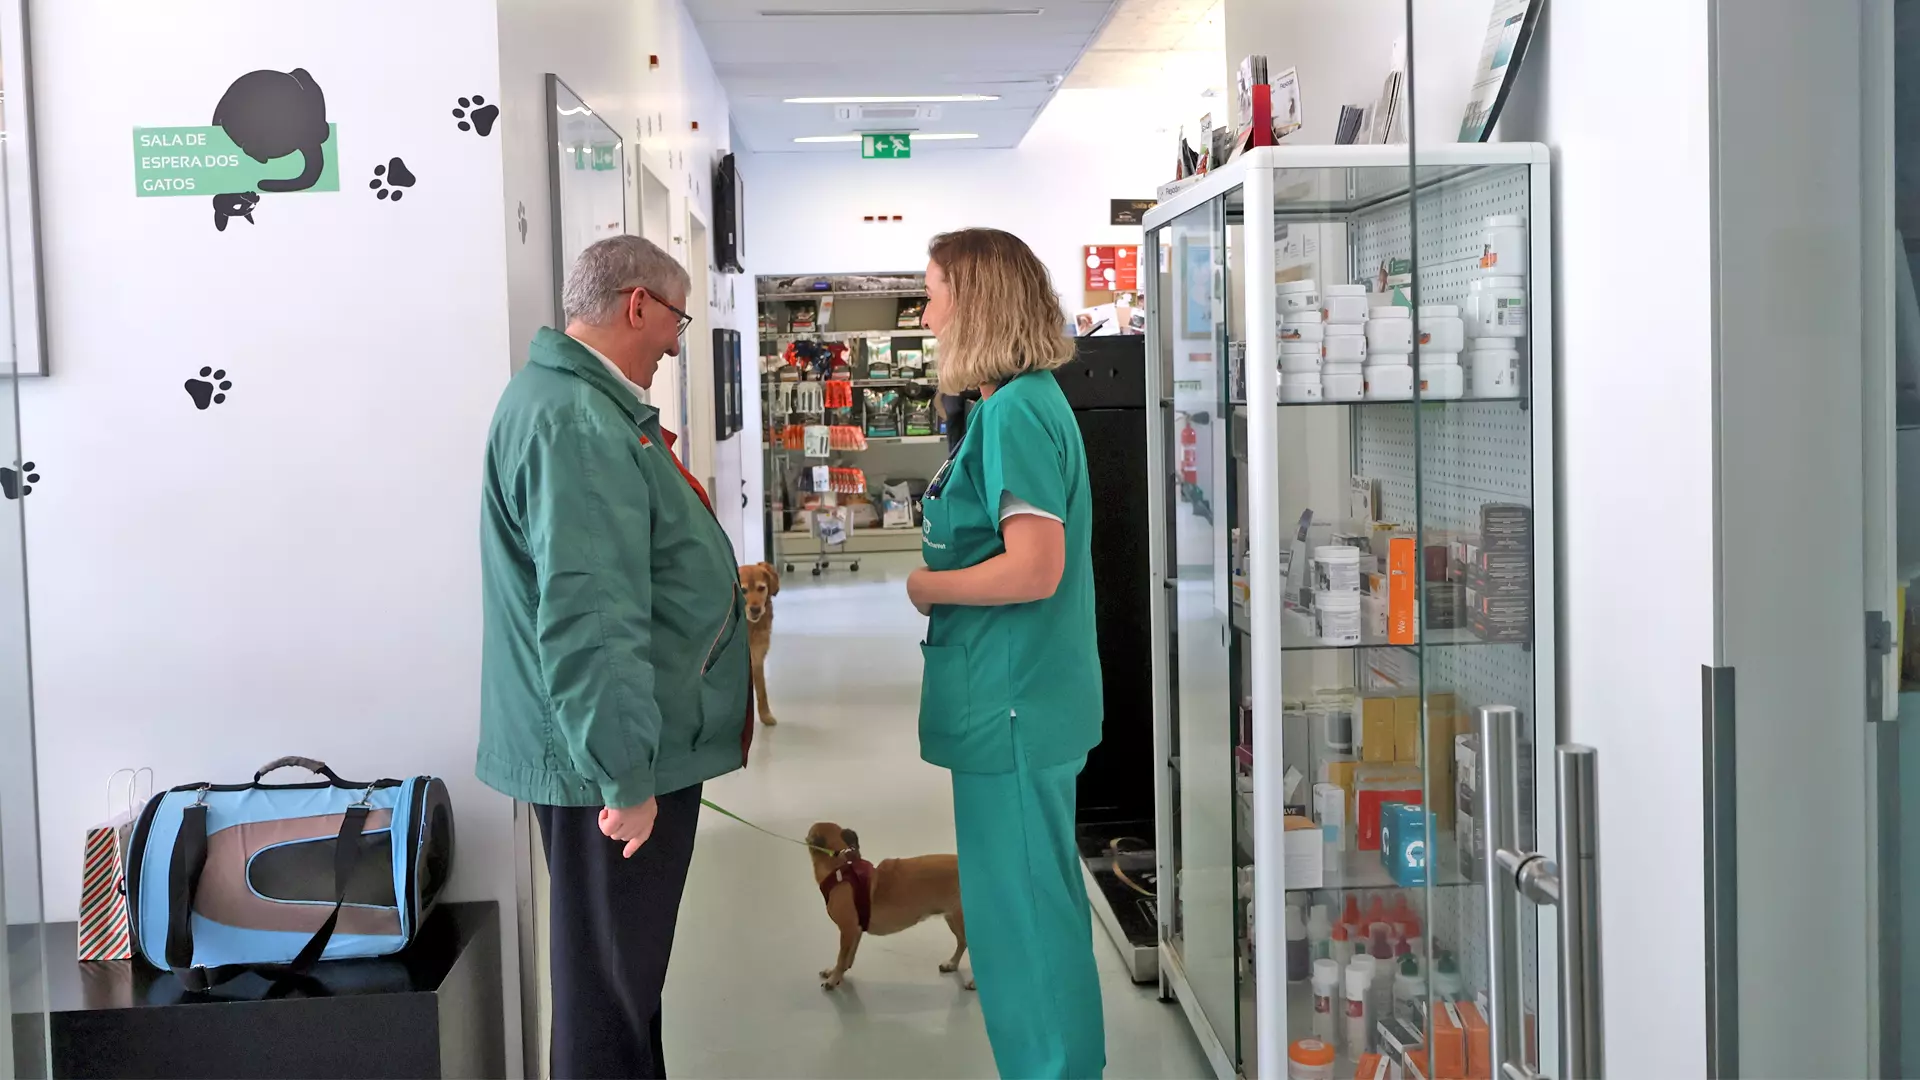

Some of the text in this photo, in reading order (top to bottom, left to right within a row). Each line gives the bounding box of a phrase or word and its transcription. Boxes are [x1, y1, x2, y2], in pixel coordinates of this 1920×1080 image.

[140, 133, 207, 147] SALA DE
[141, 154, 239, 169] ESPERA DOS
[143, 178, 195, 191] GATOS
